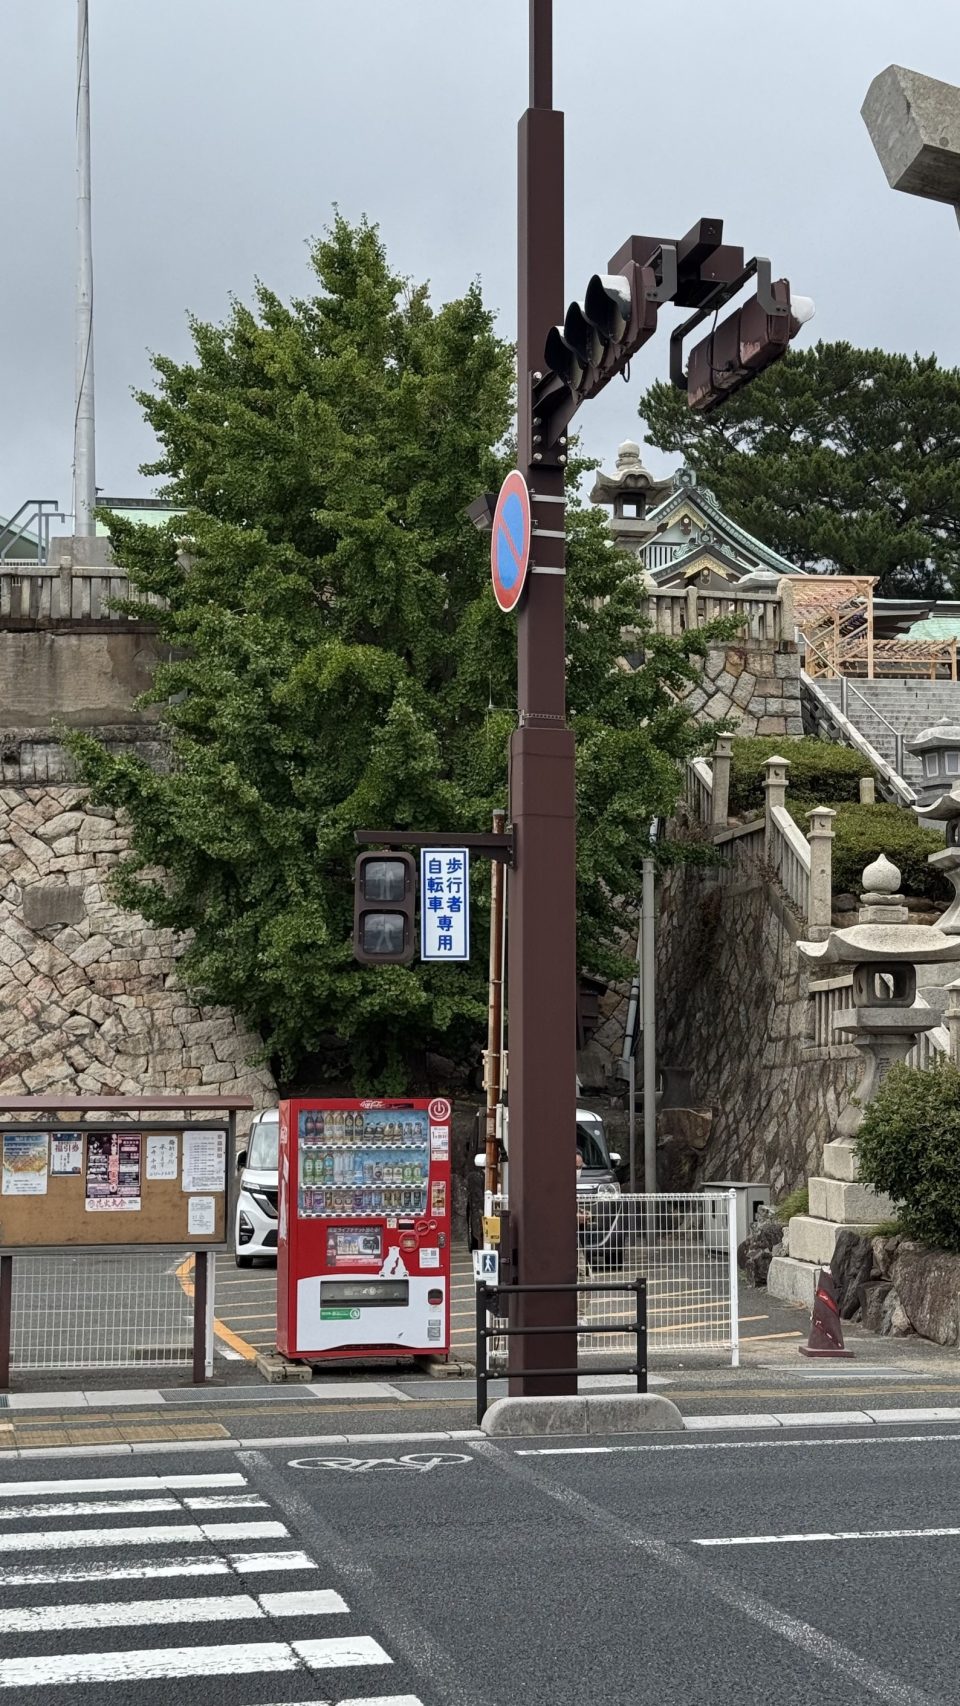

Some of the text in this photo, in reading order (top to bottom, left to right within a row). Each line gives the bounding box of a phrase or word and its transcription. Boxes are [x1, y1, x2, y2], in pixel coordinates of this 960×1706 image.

[427, 857, 444, 913] 自転車
[446, 857, 463, 913] 歩行者
[436, 915, 454, 952] 専用
